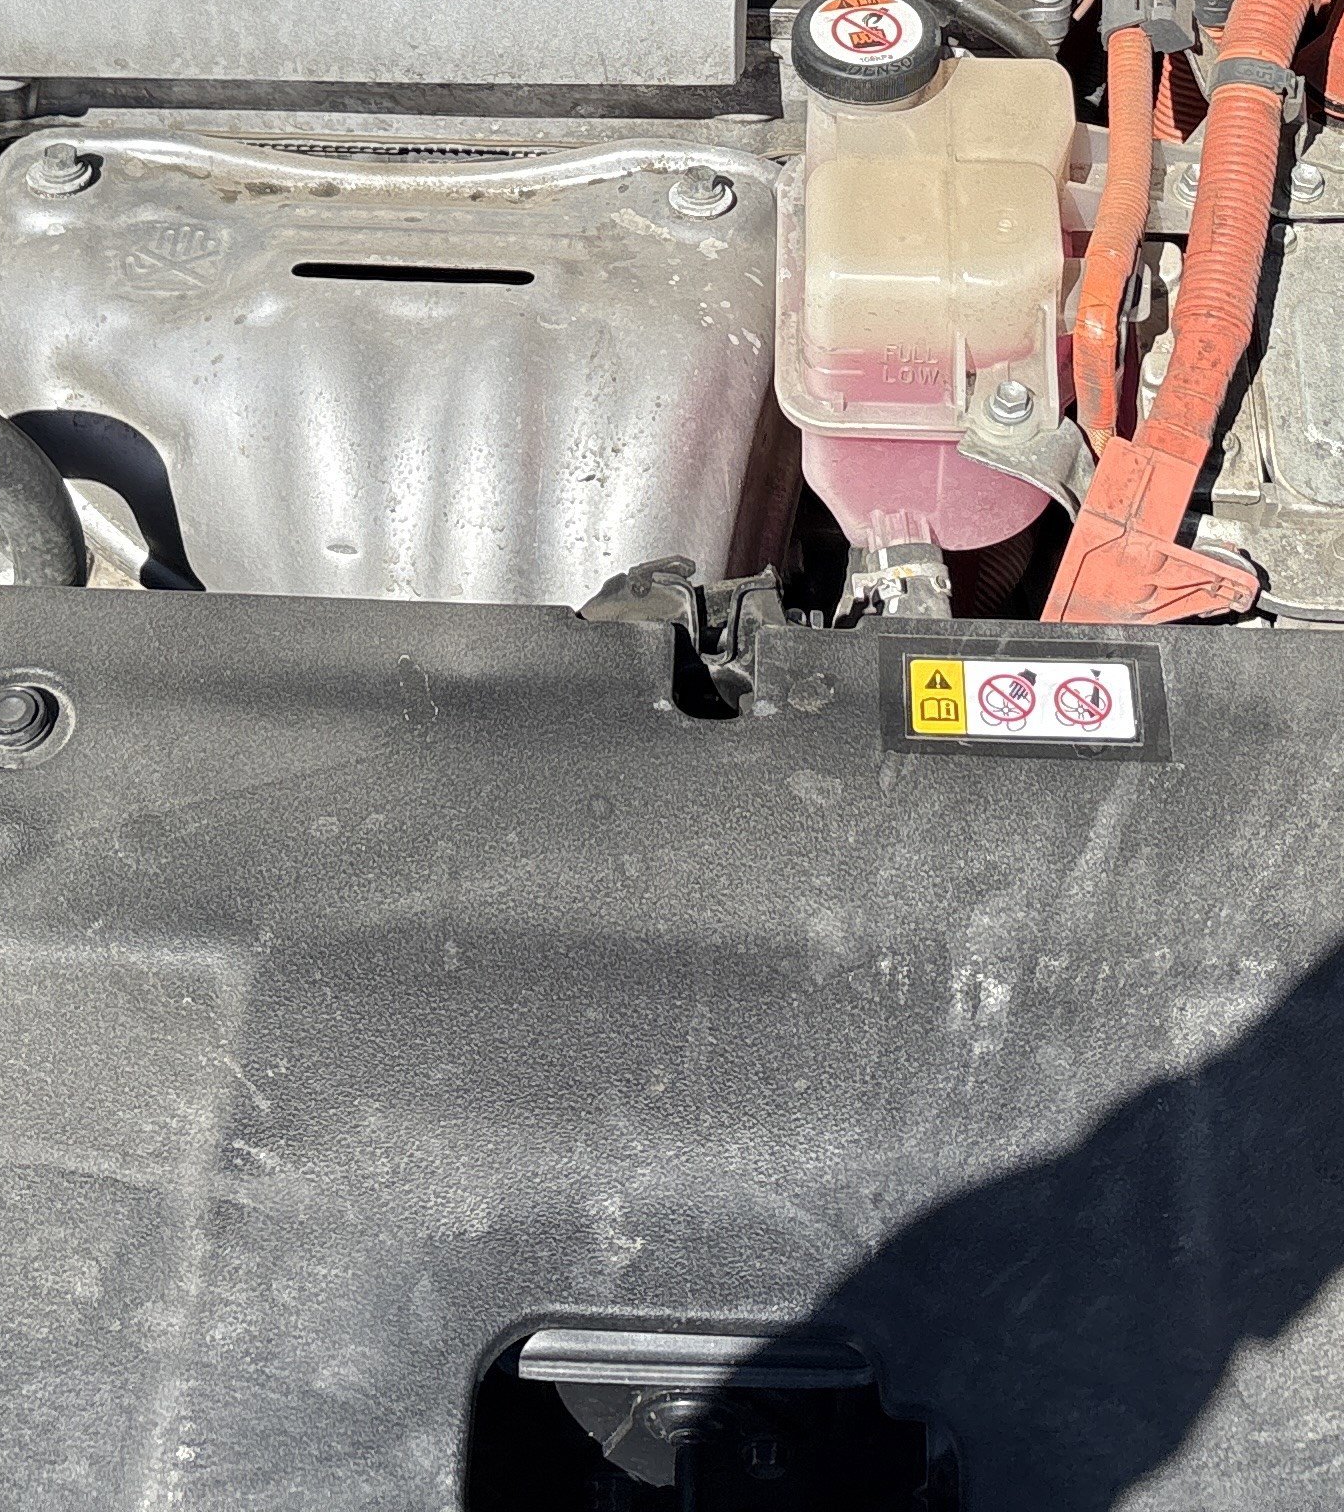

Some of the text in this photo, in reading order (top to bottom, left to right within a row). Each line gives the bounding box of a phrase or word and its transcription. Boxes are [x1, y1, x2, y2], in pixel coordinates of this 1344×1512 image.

[845, 56, 913, 77] DENSO
[884, 344, 939, 364] FULL
[883, 364, 940, 385] LOW
